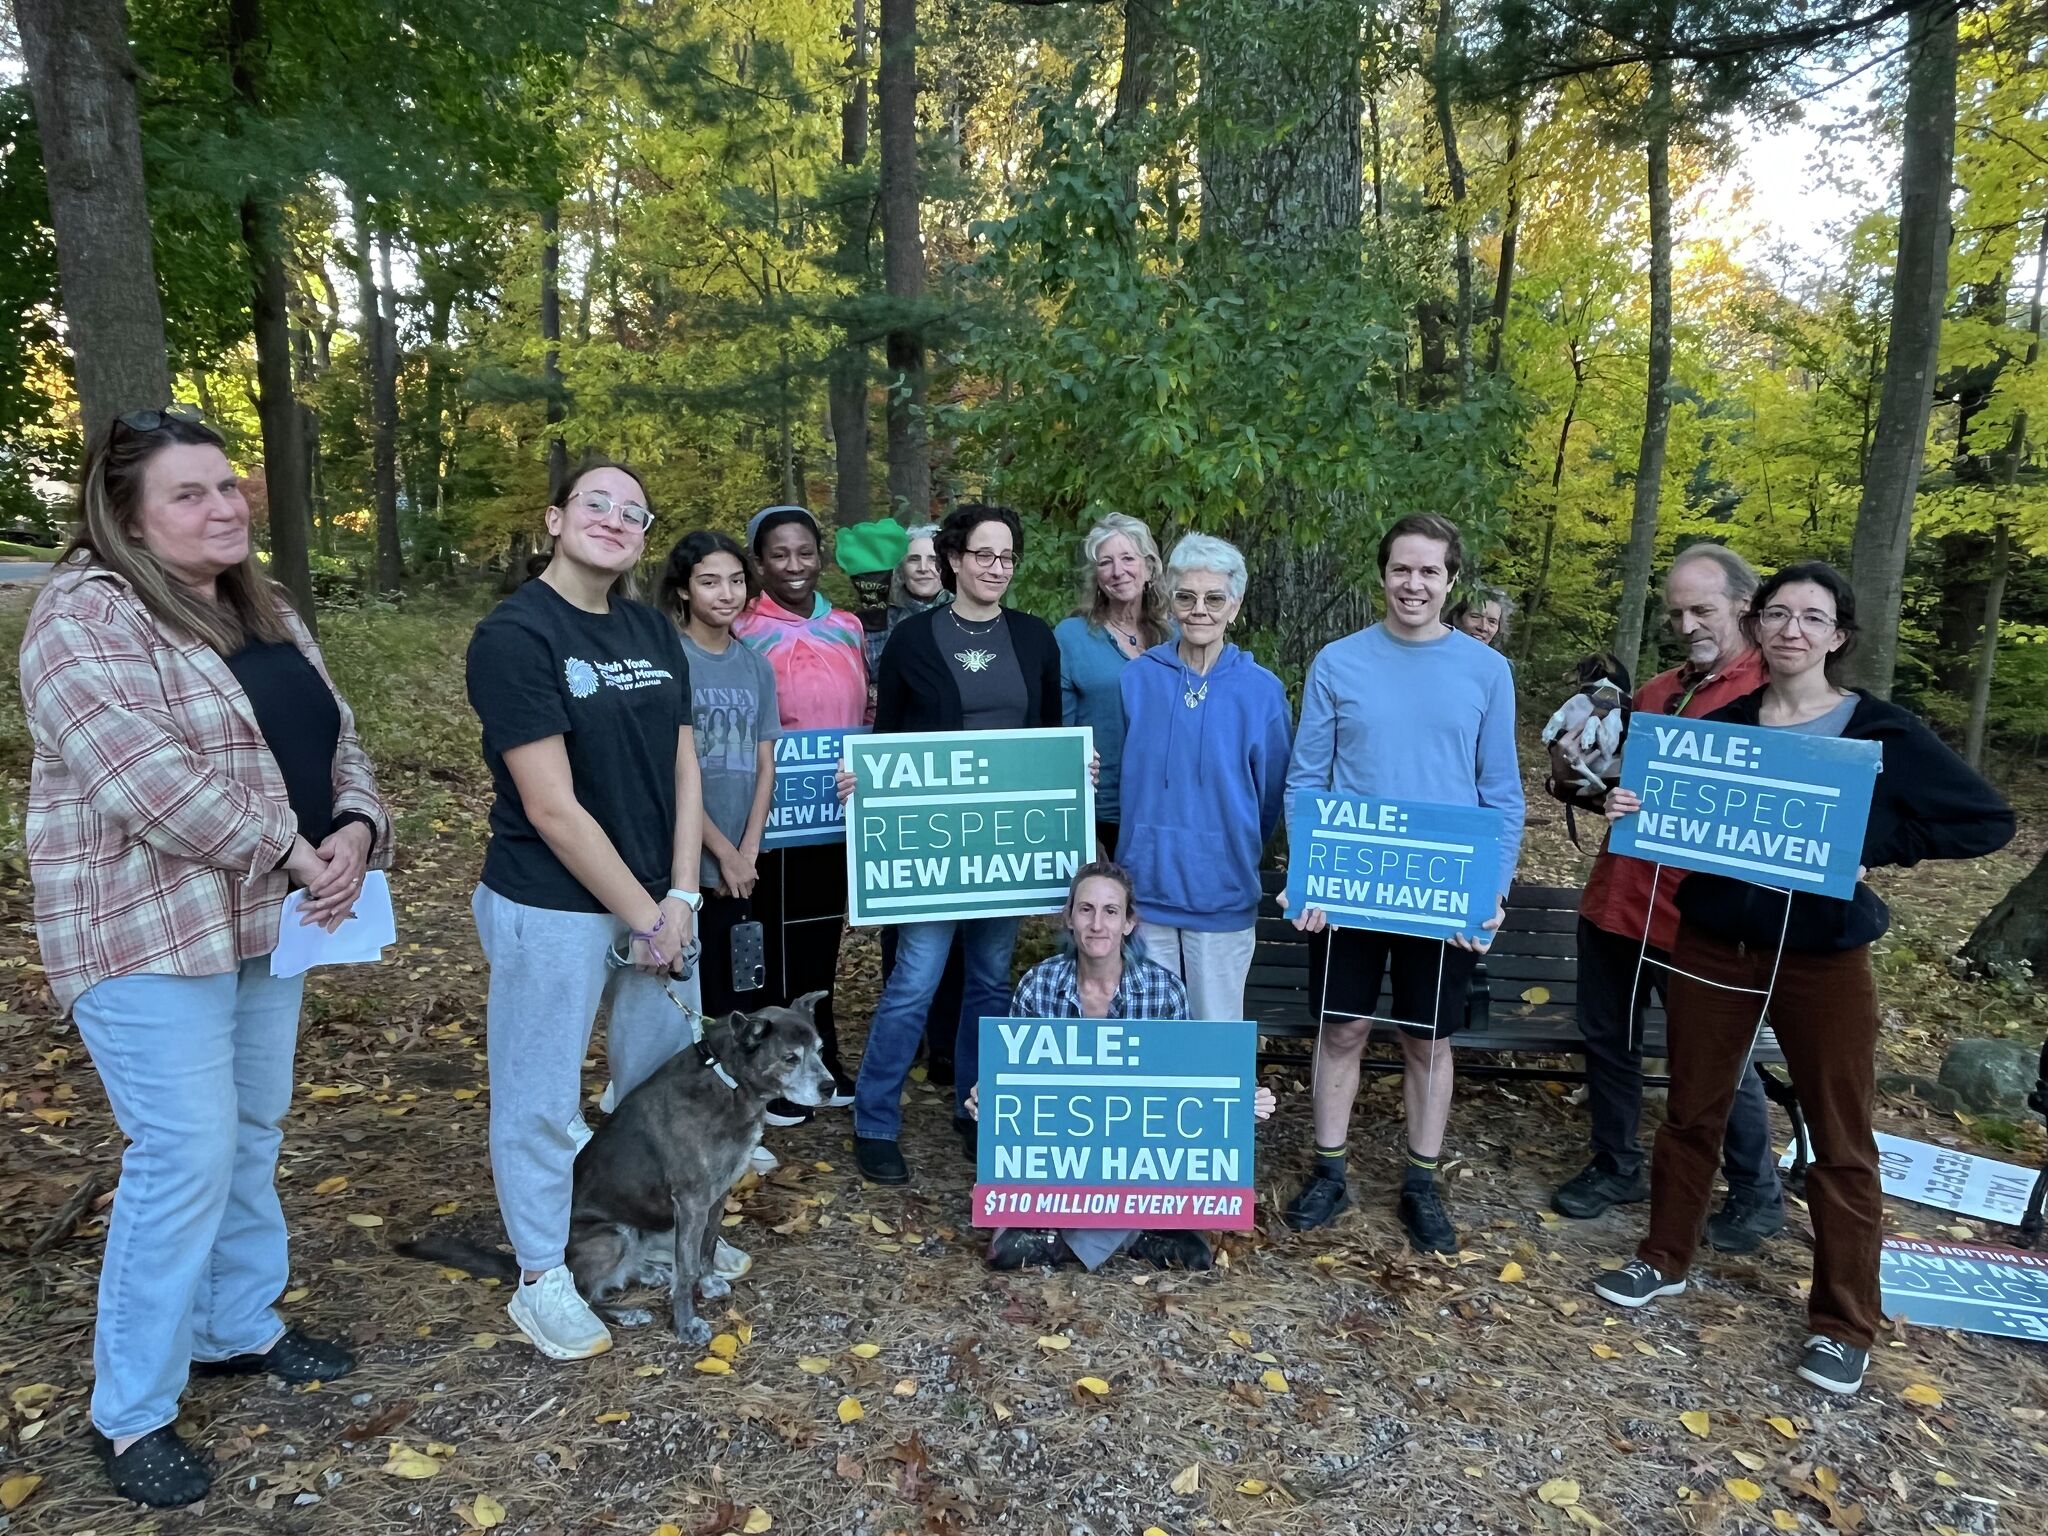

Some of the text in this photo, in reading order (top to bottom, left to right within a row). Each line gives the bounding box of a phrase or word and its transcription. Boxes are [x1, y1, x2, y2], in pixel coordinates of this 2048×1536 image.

[623, 658, 653, 670] Youth
[1654, 726, 1762, 769] YALE:
[773, 775, 836, 802] RESP
[862, 750, 989, 790] YALE:
[765, 803, 846, 828] NEW HA
[1315, 798, 1409, 833] YALE:
[1642, 775, 1838, 834] RESPECT
[863, 807, 1078, 852] RESPECT
[1637, 810, 1831, 867] NEW HAVEN
[864, 850, 1079, 890] NEW HAVEN
[1308, 843, 1473, 886] RESPECT
[1306, 874, 1469, 915] NEW HAVEN
[998, 1024, 1140, 1067] YALE:
[994, 1094, 1241, 1139] RESPECT
[994, 1145, 1239, 1182] NEW HAVEN
[1878, 1151, 1914, 1181] OUR
[1921, 1149, 1974, 1209] RESPECT
[984, 1190, 1243, 1216] $110 MILLION EVERY YEAR
[1880, 1250, 2048, 1284] EW HAVE
[1938, 1245, 2018, 1263] MILLION
[1992, 1310, 2048, 1337] E:
